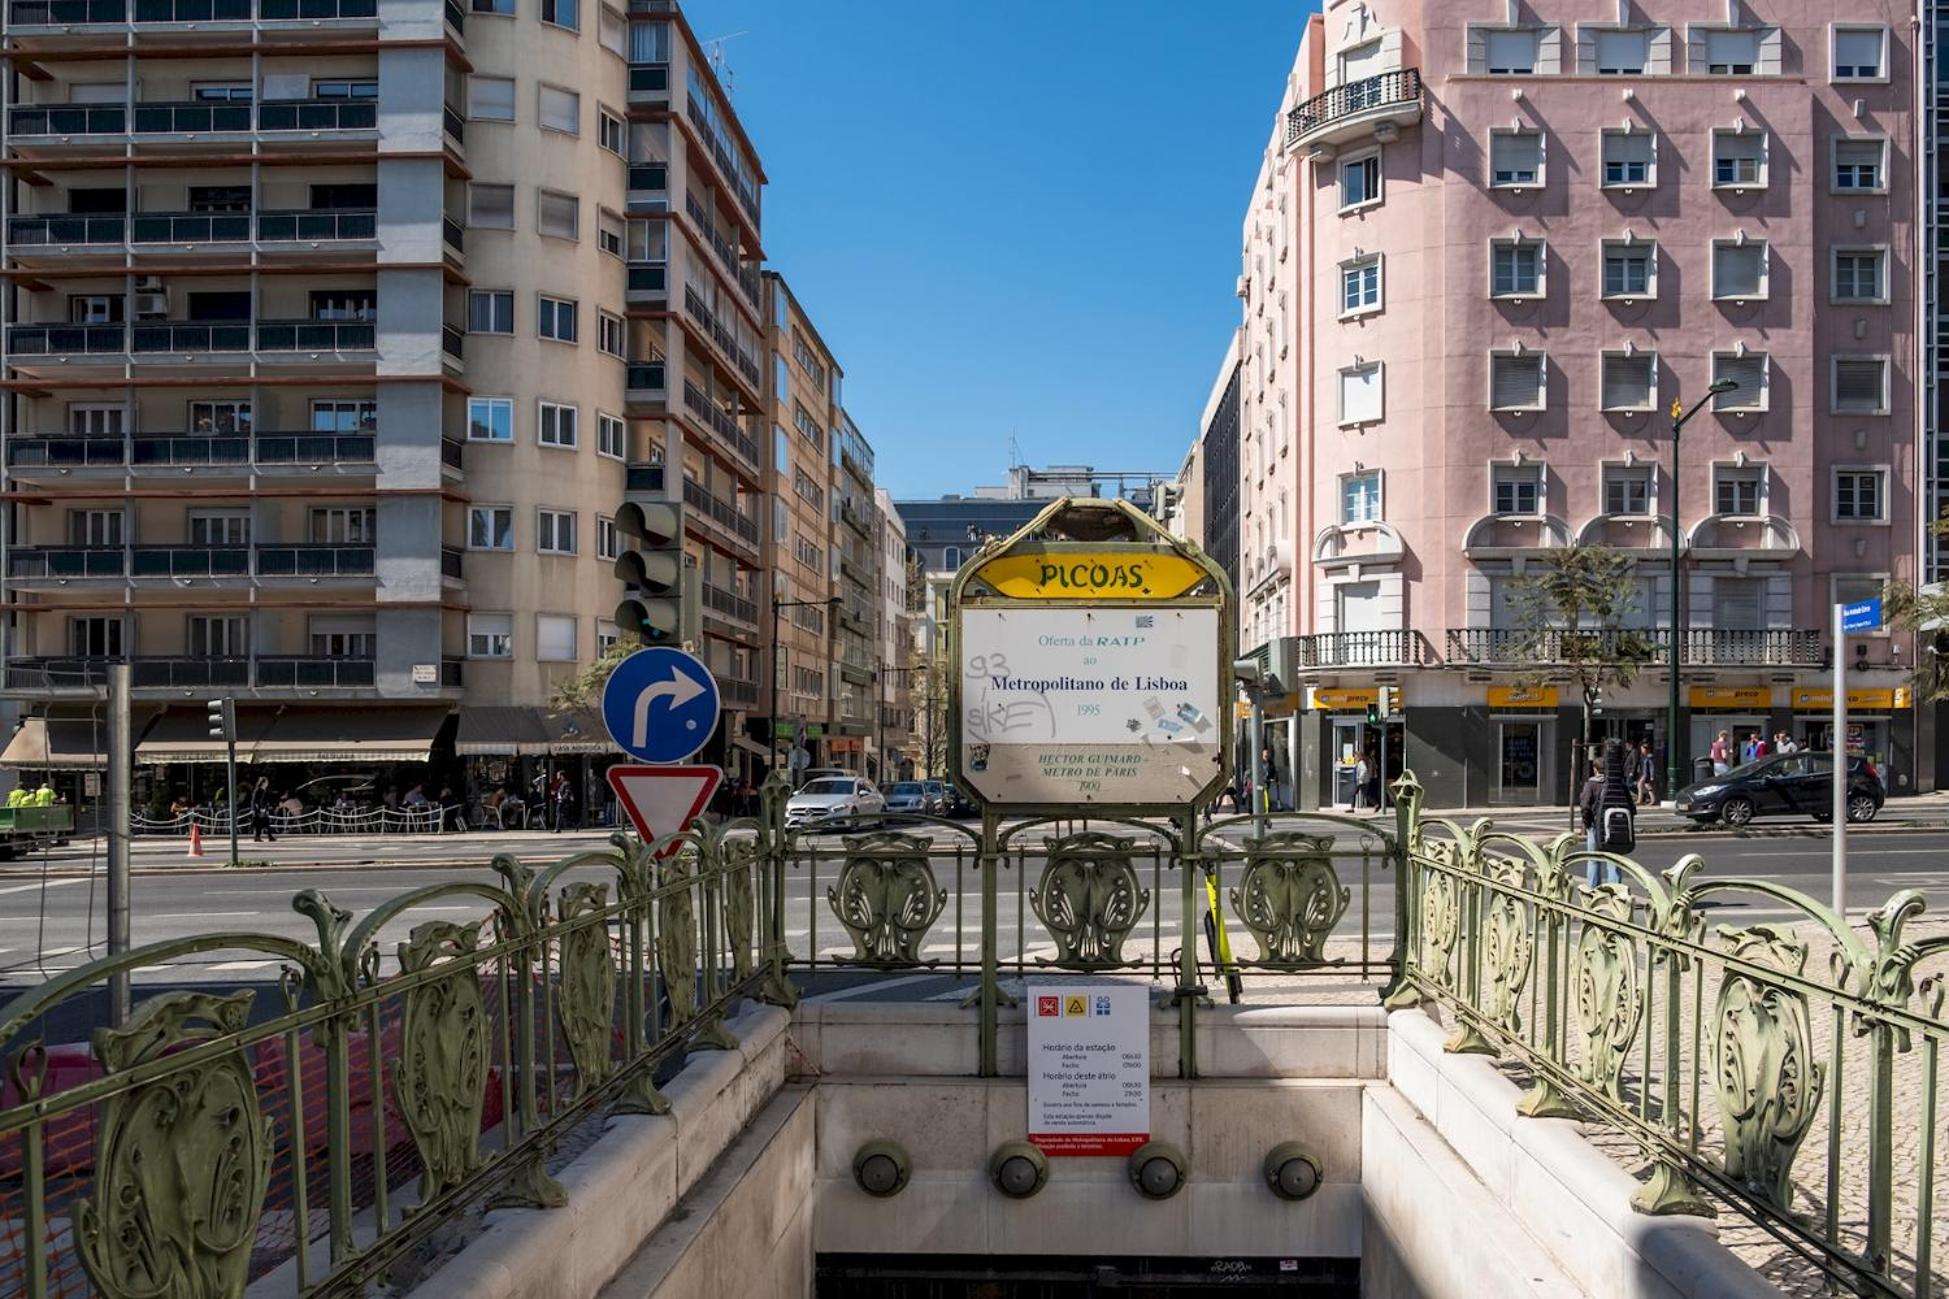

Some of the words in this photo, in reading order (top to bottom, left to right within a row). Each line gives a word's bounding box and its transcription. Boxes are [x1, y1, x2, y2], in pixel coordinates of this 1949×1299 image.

[1040, 564, 1143, 588] PICOAS
[1038, 634, 1075, 647] Oferta
[1079, 634, 1094, 647] da
[1096, 636, 1146, 647] RATP
[965, 653, 1011, 679] 93
[1083, 656, 1097, 665] ao
[992, 676, 1105, 694] Metropolitano
[1110, 676, 1130, 691] de
[1135, 676, 1188, 691] Lisboa
[1077, 703, 1101, 716] 1995
[1038, 754, 1085, 764] HECTOR
[1087, 754, 1143, 764] GUIMARD
[1085, 767, 1101, 777] DE
[1104, 767, 1138, 777] PARIS
[1042, 1043, 1072, 1052] Horário
[1073, 1043, 1084, 1052] da
[1085, 1043, 1116, 1053] estação
[1042, 1072, 1072, 1080] Horário
[1073, 1072, 1096, 1080] deste
[1097, 1072, 1116, 1080] átrio
